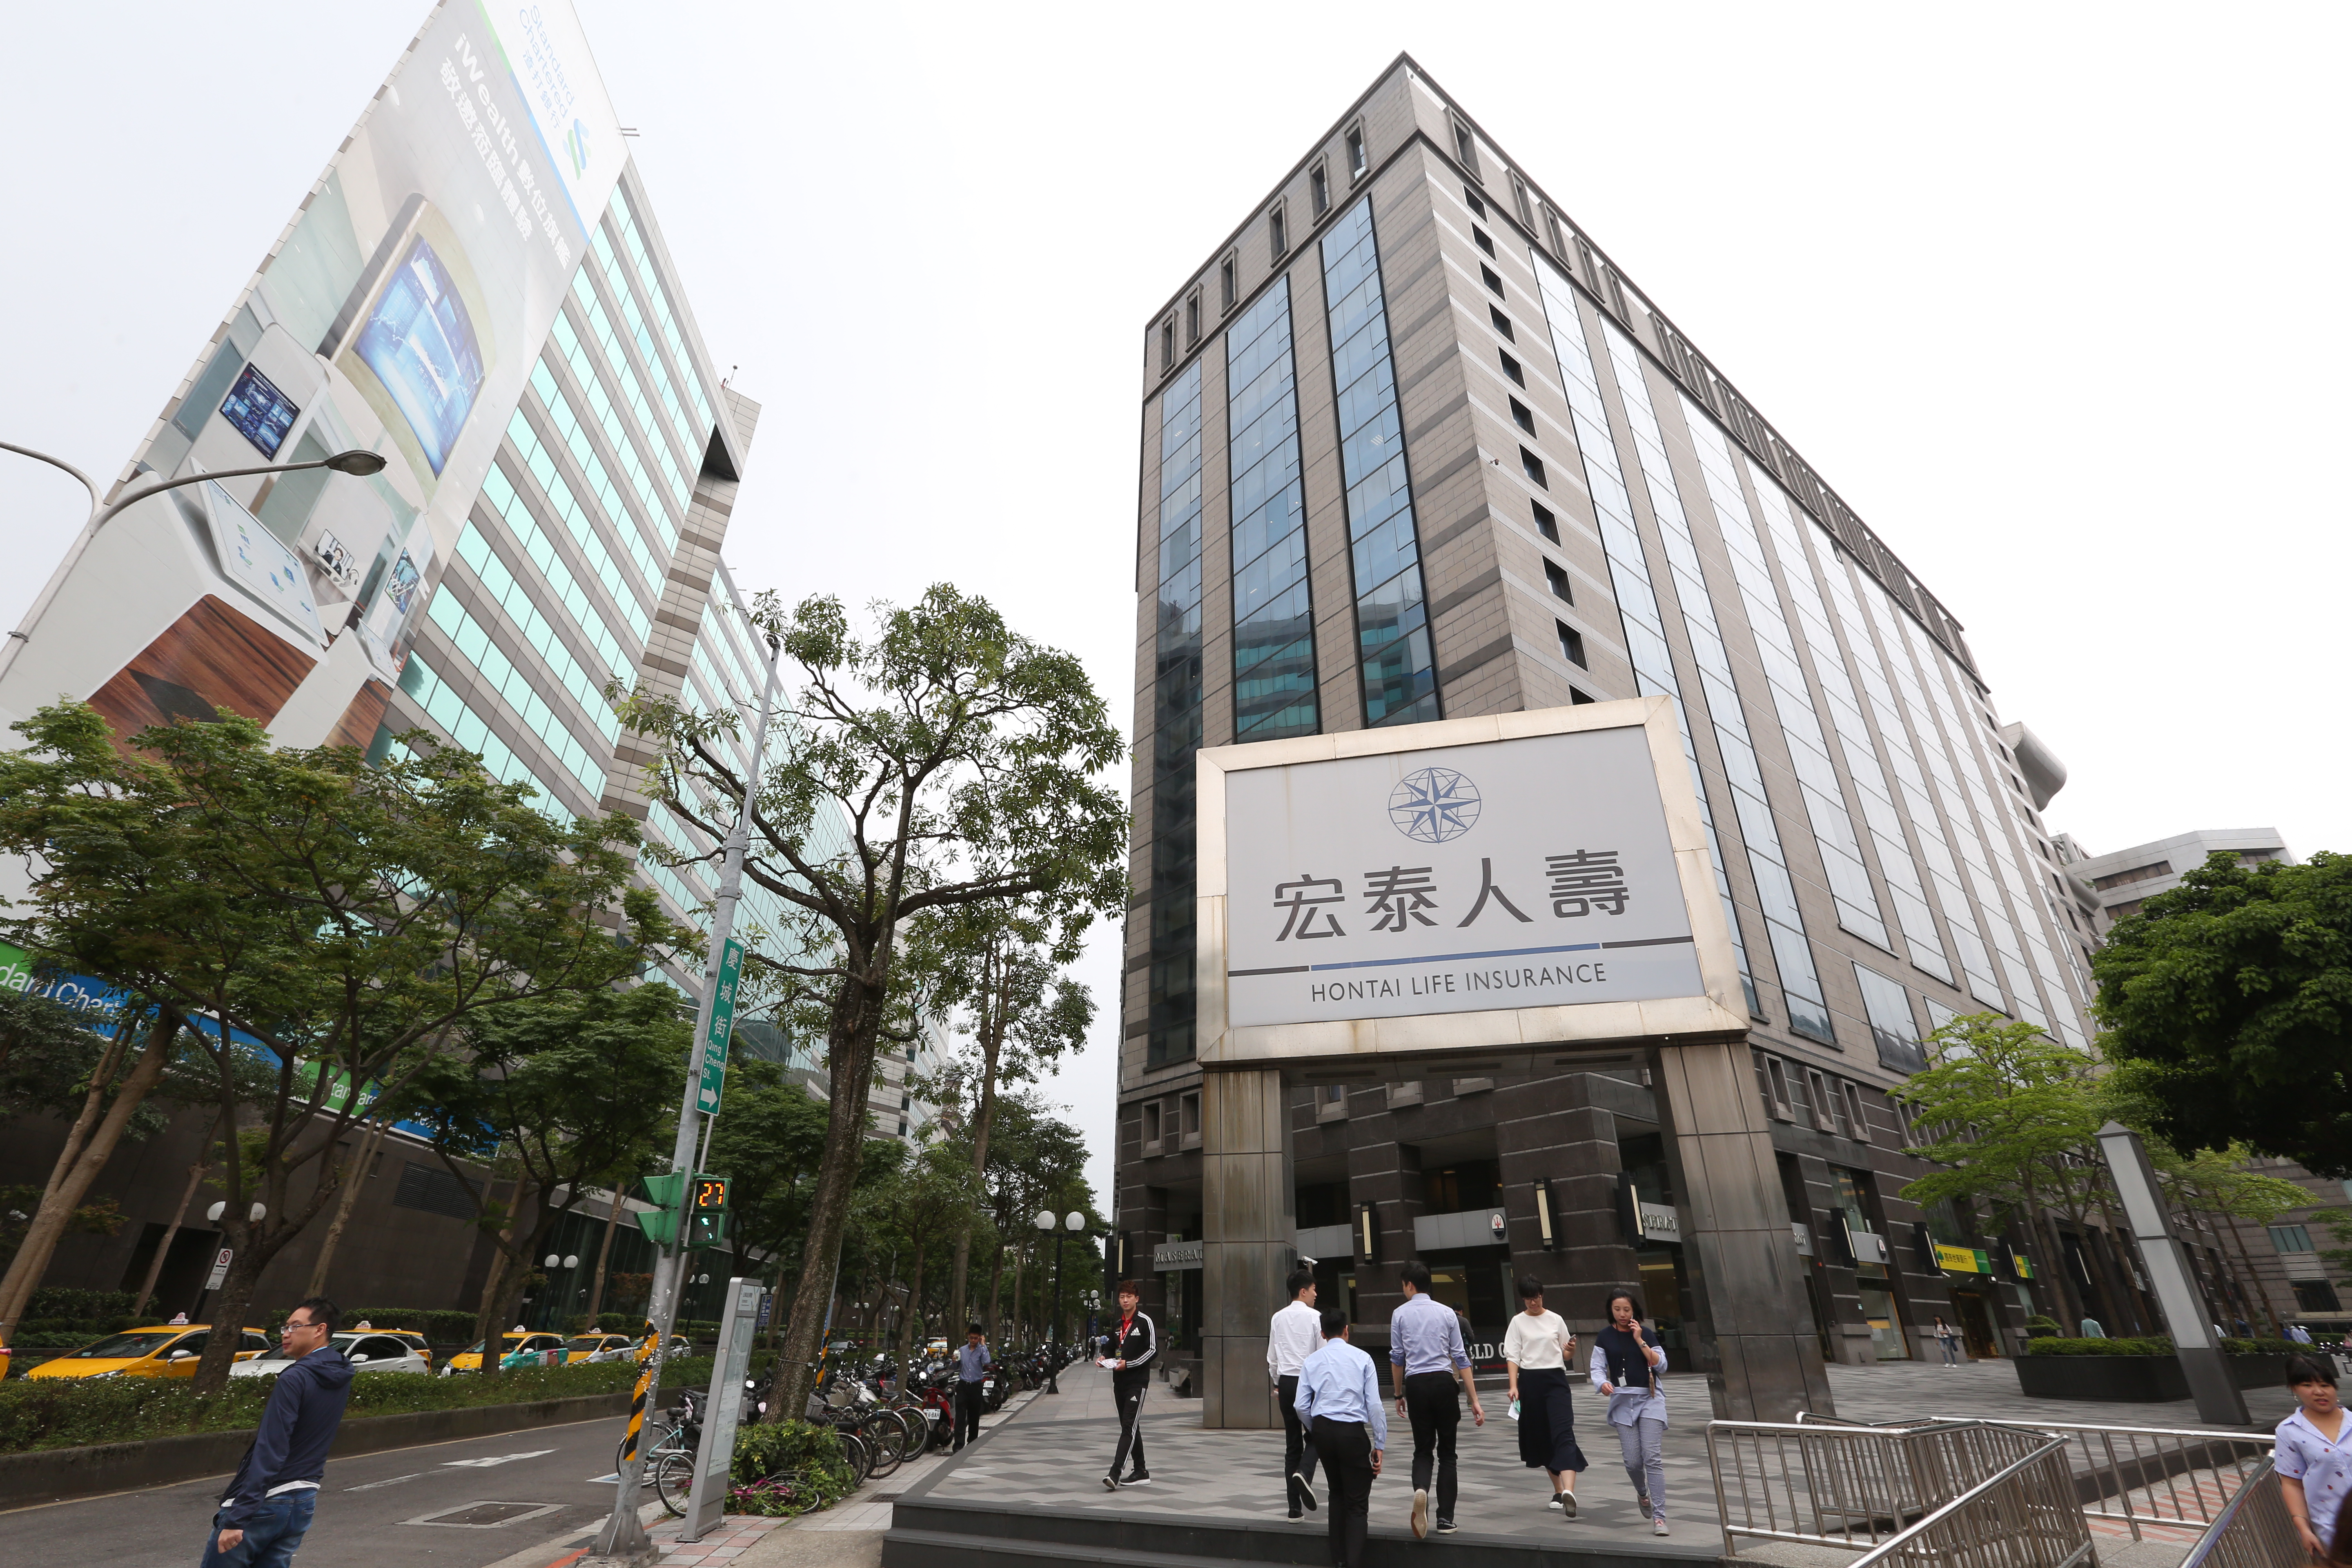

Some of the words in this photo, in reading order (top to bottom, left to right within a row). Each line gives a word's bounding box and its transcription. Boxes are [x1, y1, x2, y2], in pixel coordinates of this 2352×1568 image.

[519, 9, 568, 118] Chartered
[530, 5, 575, 106] Standard
[522, 51, 560, 129] 渣打銀行
[440, 58, 535, 241] 敬邀蒞臨體驗
[454, 33, 518, 165] iWealth
[517, 160, 570, 270] 數位旗艦
[1274, 849, 1630, 941] 宏泰人壽
[715, 947, 739, 1038] 慶城街
[1312, 979, 1401, 1002] HONTAI
[1413, 974, 1455, 995] LIFE
[1467, 962, 1606, 991] INSURANCE
[703, 1068, 711, 1080] St.
[705, 1054, 724, 1073] Cheng
[707, 1040, 722, 1056] Qing
[699, 1183, 724, 1207] 27
[1642, 1214, 1678, 1230] SERAT
[1156, 1249, 1203, 1263] MASERAT
